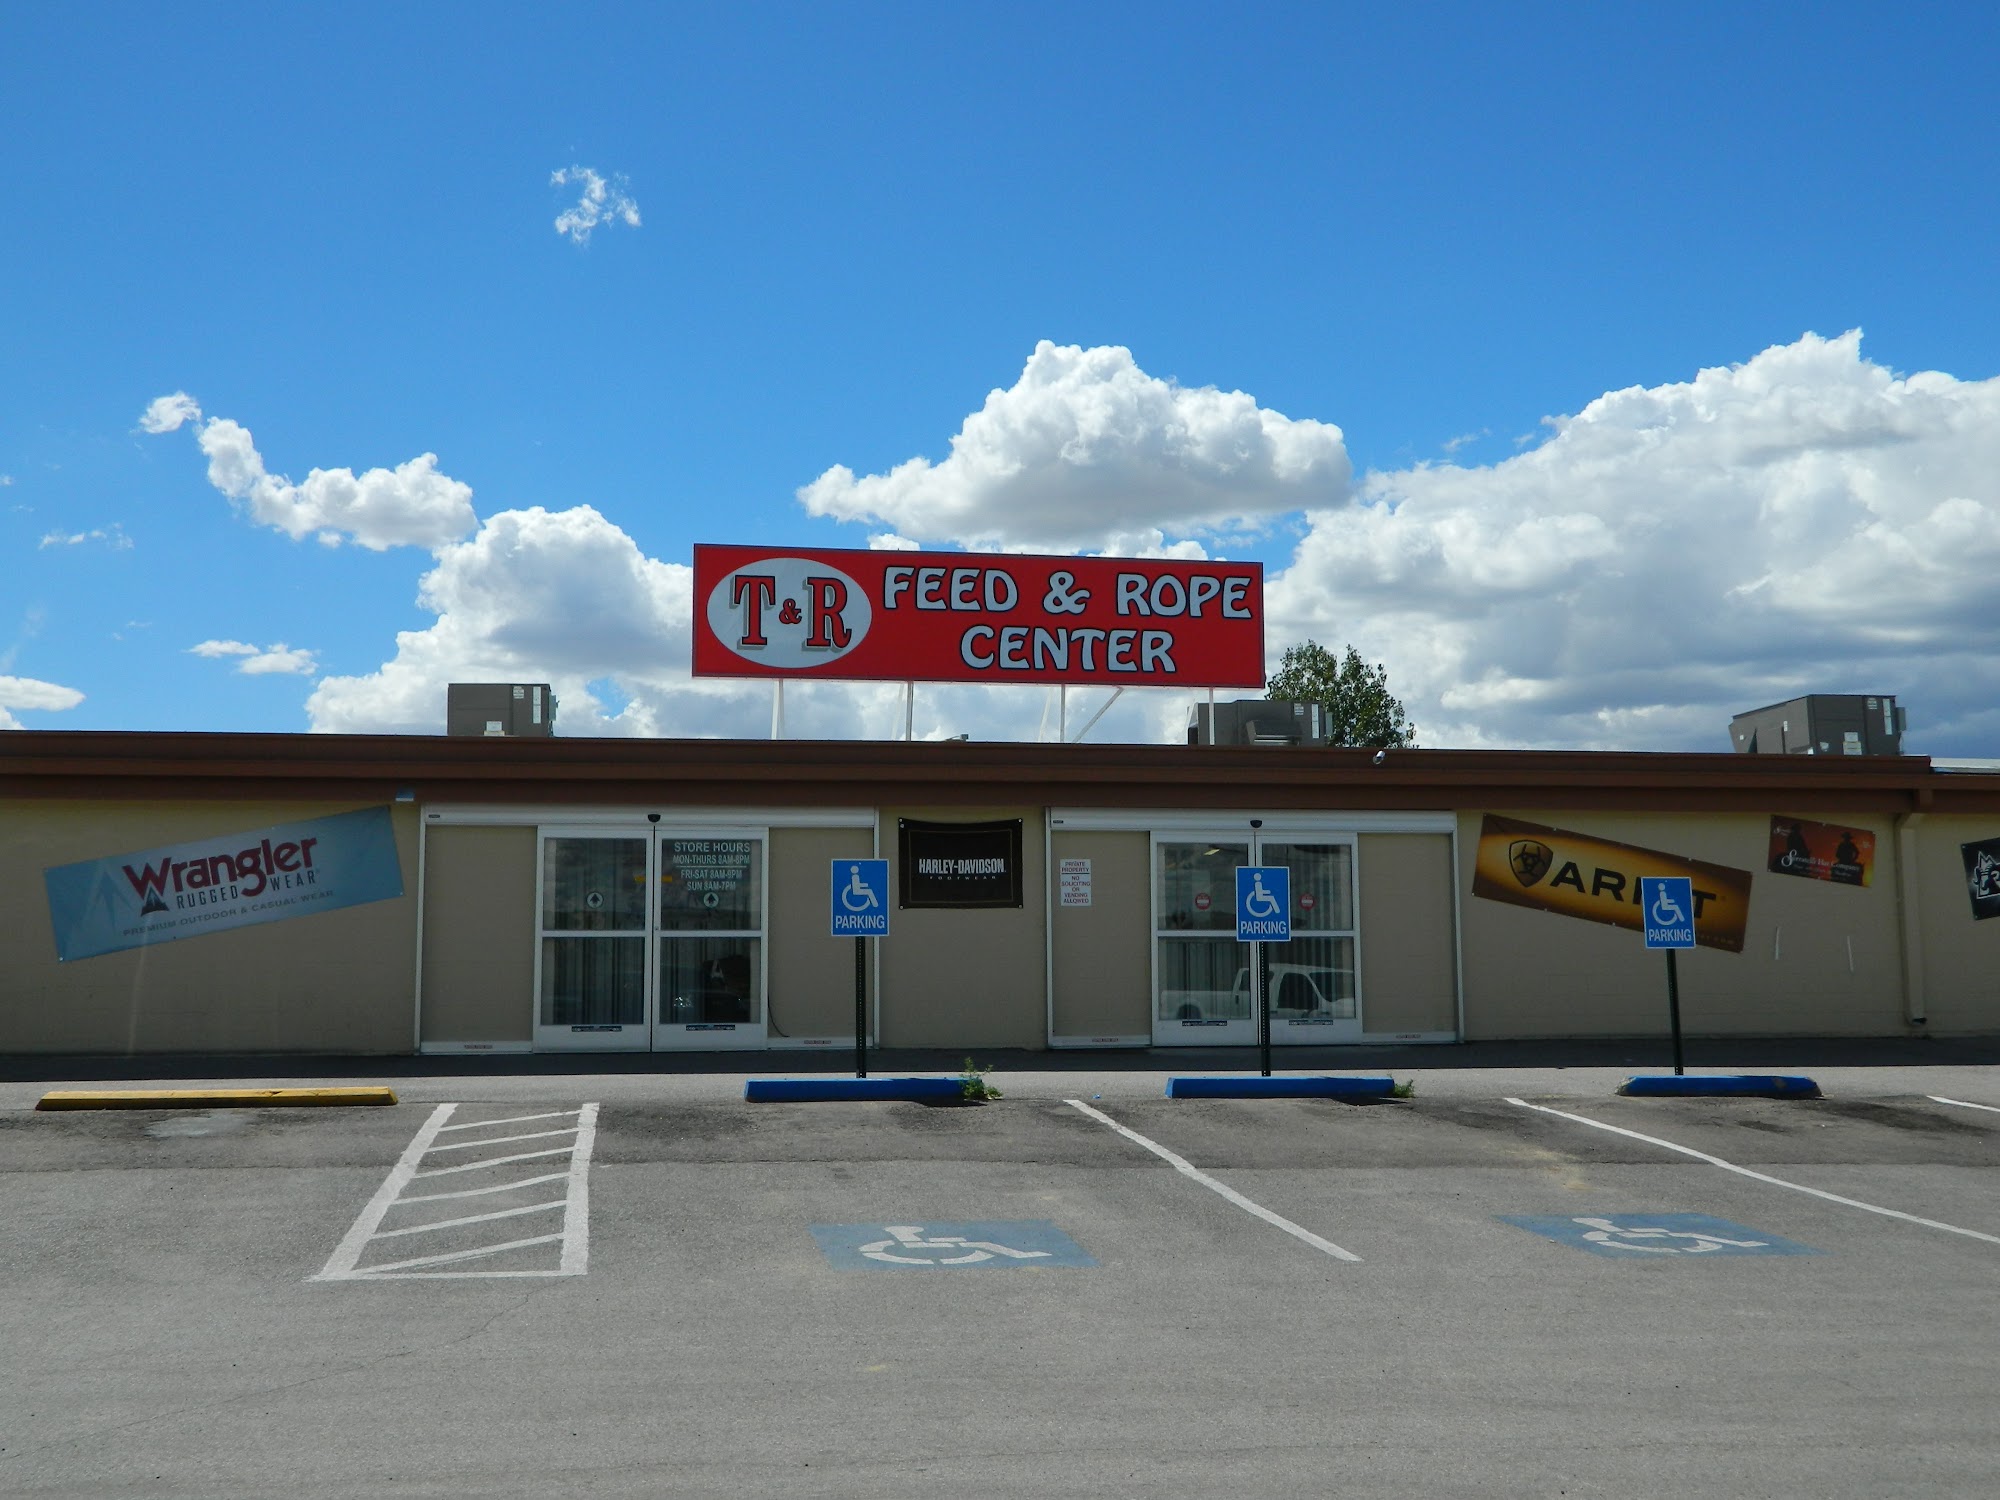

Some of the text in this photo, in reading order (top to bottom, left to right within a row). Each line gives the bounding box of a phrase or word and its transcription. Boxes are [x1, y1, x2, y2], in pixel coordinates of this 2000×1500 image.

[884, 565, 1253, 620] FEED & ROPE
[961, 624, 1177, 673] CENTER
[674, 842, 751, 852] STORE HOURS
[672, 854, 717, 864] MON-THURS
[918, 858, 1004, 874] HARLEY-DAVIDSON
[122, 837, 318, 898] Wrangler
[681, 869, 708, 879] FRI-SAT
[176, 870, 316, 909] RUGGED WEAR
[687, 881, 703, 891] SUN
[1550, 861, 1717, 919] ARIT
[122, 889, 334, 937] PREMIUM OUTDOOR & CASUAL WEAR
[835, 915, 885, 929] PARKING
[1240, 920, 1287, 934] PARKING
[1648, 928, 1692, 942] PARKING
